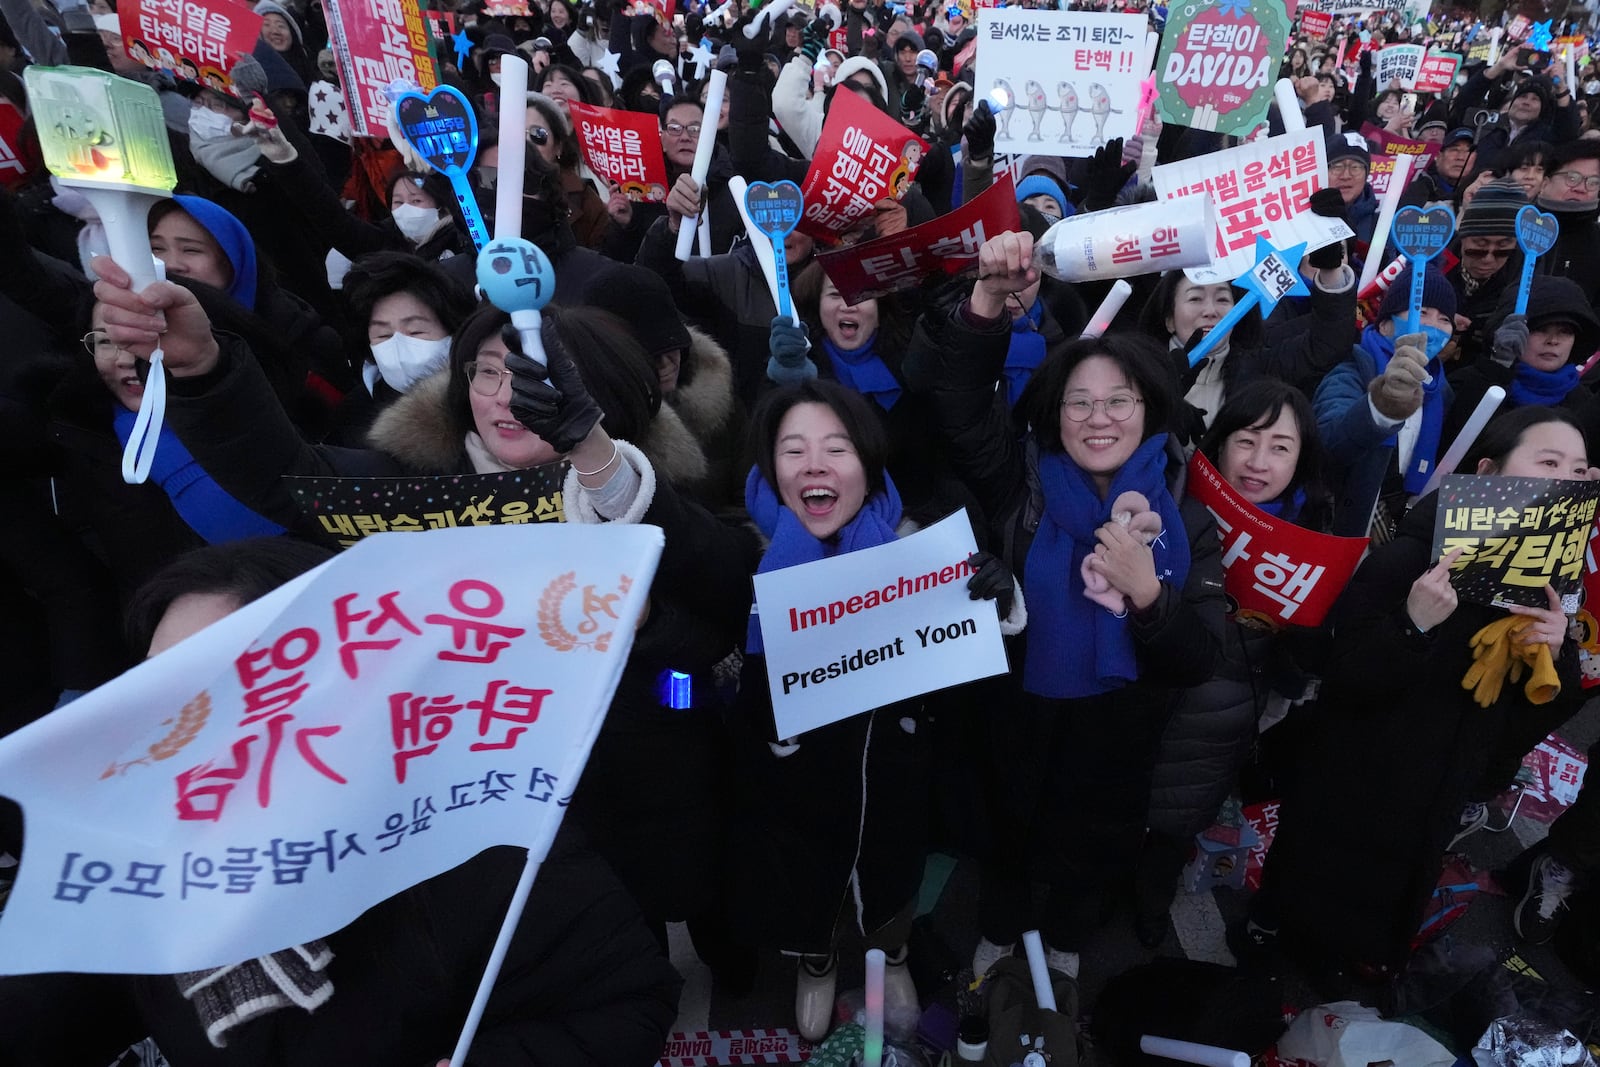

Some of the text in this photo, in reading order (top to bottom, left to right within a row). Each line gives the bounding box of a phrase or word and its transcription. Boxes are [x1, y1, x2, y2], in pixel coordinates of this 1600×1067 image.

[139, 14, 227, 71] 탄핵하라
[989, 22, 1134, 45] 질서있는 조기 퇴진~
[1186, 23, 1261, 52] 탄핵이
[1074, 49, 1112, 72] 탄핵
[1162, 52, 1271, 90] DAVIDA
[416, 132, 470, 158] 이재명
[581, 121, 643, 156] 윤석열을
[587, 148, 647, 181] 탄핵하라
[805, 126, 873, 223] 윤석열을
[1244, 140, 1317, 193] 윤석열
[754, 208, 797, 223] 이재명
[860, 219, 988, 282] 탄핵
[1400, 233, 1444, 248] 이재명
[1261, 253, 1297, 301] 탄핵
[1220, 489, 1274, 532] www.nanum.com
[1444, 497, 1599, 532] 내란수괴 윤석열
[788, 551, 981, 632] Impeachment
[782, 617, 977, 695] President Yoon
[729, 1037, 789, 1055] 안전제일
